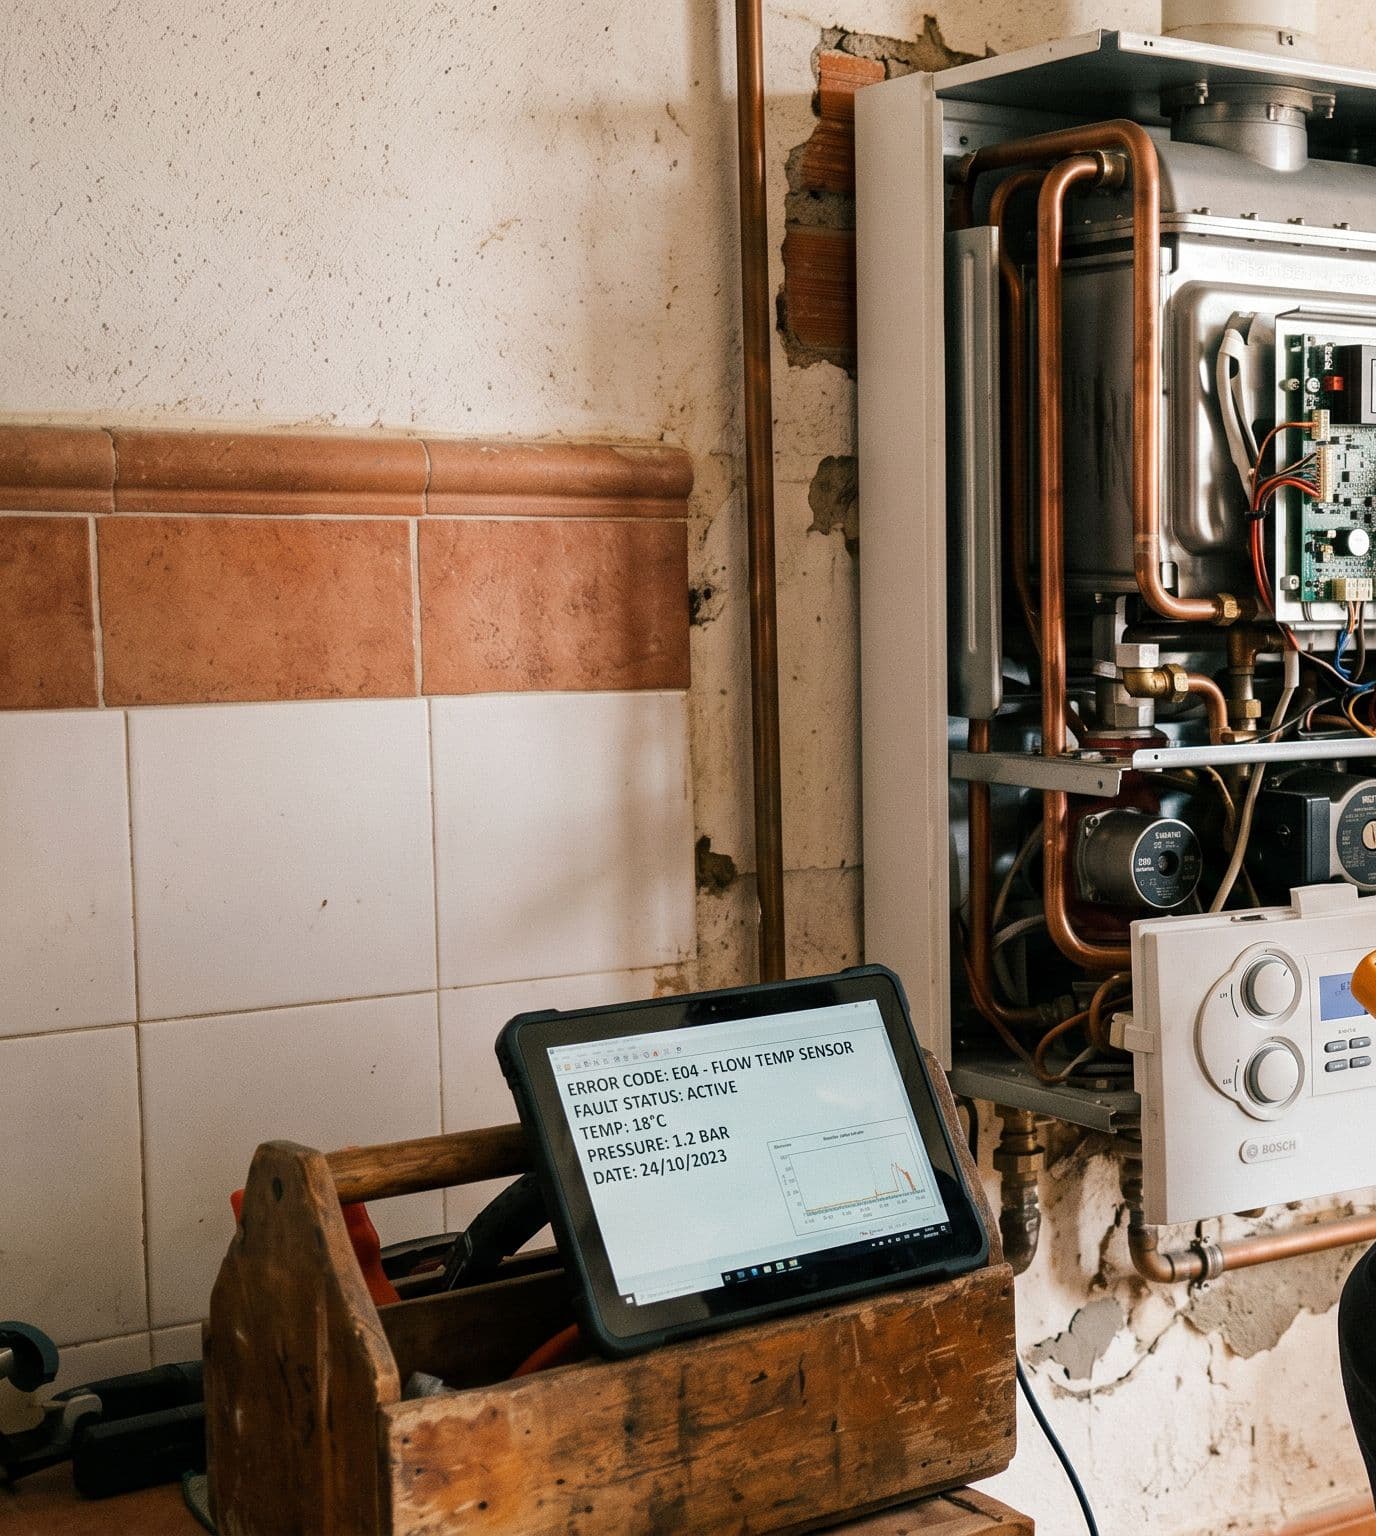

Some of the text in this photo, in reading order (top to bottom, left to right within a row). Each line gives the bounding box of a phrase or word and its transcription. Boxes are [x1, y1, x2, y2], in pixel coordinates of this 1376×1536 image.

[567, 1076, 620, 1096] ERROR
[623, 1069, 669, 1088] CODE:
[672, 1064, 699, 1080] E04
[711, 1056, 752, 1074] FLOW
[755, 1050, 795, 1067] TEMP
[799, 1041, 854, 1061] SENSOR
[573, 1080, 738, 1118] FAULT STATUS: ACTIVE
[579, 1114, 667, 1140] TEMP: 18°C
[587, 1126, 730, 1162] PRESSURE: 1.2 BAR
[1262, 1140, 1297, 1155] BOSCH
[593, 1149, 728, 1185] DATE: 24/10/2023
